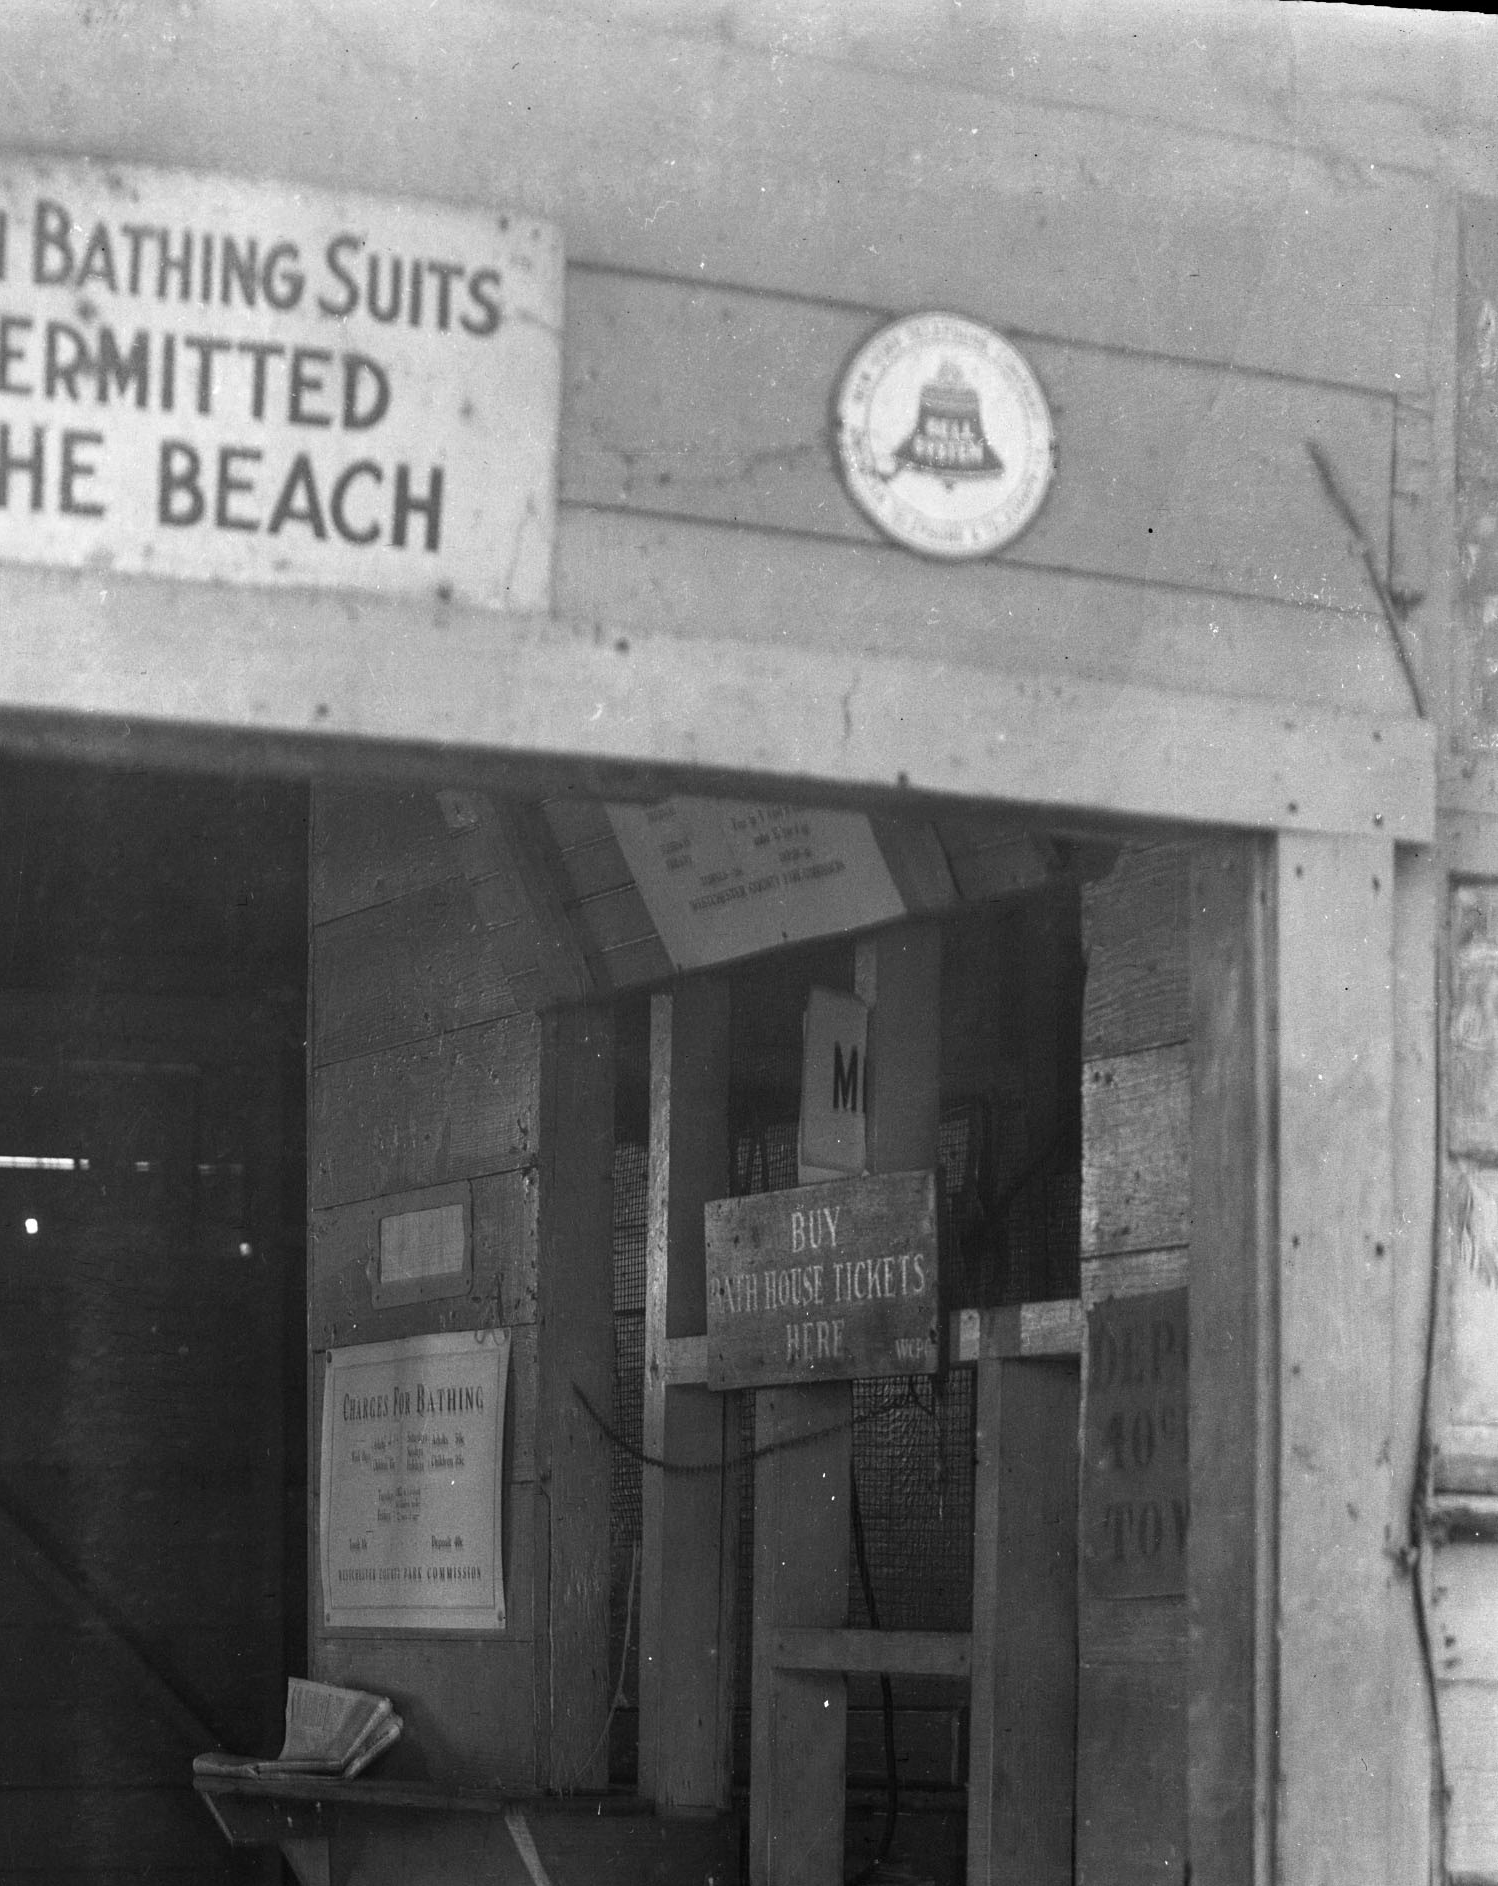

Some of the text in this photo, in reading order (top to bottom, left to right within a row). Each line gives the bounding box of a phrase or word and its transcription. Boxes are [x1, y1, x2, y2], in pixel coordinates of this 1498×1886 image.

[32, 200, 303, 312] BATHING
[317, 235, 504, 337] SUITS
[156, 439, 447, 552] BEACH
[791, 1205, 840, 1253] BUY
[765, 1265, 825, 1310] HOUSE
[833, 1253, 926, 1302] TICKETS
[786, 1319, 845, 1362] HERE
[342, 1383, 485, 1421] CHARGES FOR BATHING
